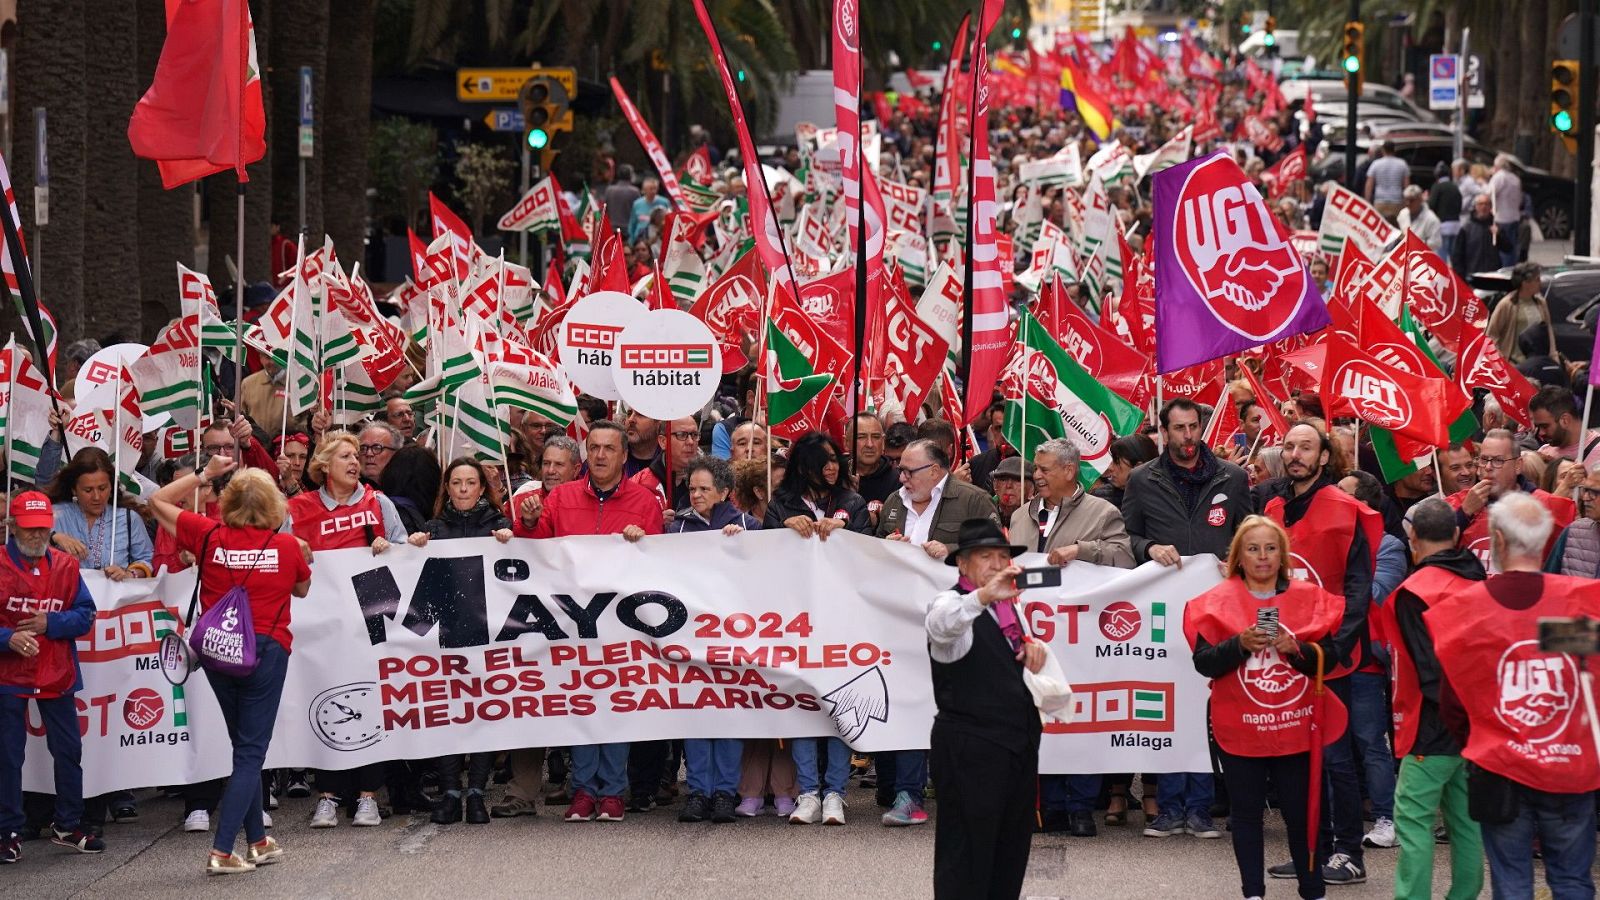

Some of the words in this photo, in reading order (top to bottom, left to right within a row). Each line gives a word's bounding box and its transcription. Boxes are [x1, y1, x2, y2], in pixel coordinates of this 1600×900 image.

[502, 187, 550, 229] CCOO
[1331, 189, 1392, 243] CCOO
[1184, 181, 1287, 270] UGT
[571, 327, 614, 346] CCO
[625, 350, 684, 364] CCOO
[633, 369, 701, 386] hábitat
[1340, 368, 1398, 410] UGT
[1056, 402, 1099, 447] Andalucía
[6, 596, 65, 614] CCOO
[694, 612, 813, 639] 2024
[1024, 601, 1090, 645] GT
[202, 640, 244, 658] LUCHA
[378, 655, 471, 681] POR
[484, 647, 539, 672] EL
[550, 640, 692, 668] PLENO
[706, 642, 892, 669] EMPLEO:
[1095, 643, 1168, 660] Málaga
[380, 670, 546, 706] MENOS
[559, 663, 778, 692] JORNADA,
[1502, 657, 1565, 699] UGT
[383, 694, 597, 731] MEJORES
[610, 687, 821, 714] SALARIOS
[1242, 713, 1276, 725] mano
[120, 730, 190, 748] Málaga
[1111, 733, 1173, 750] Málaga
